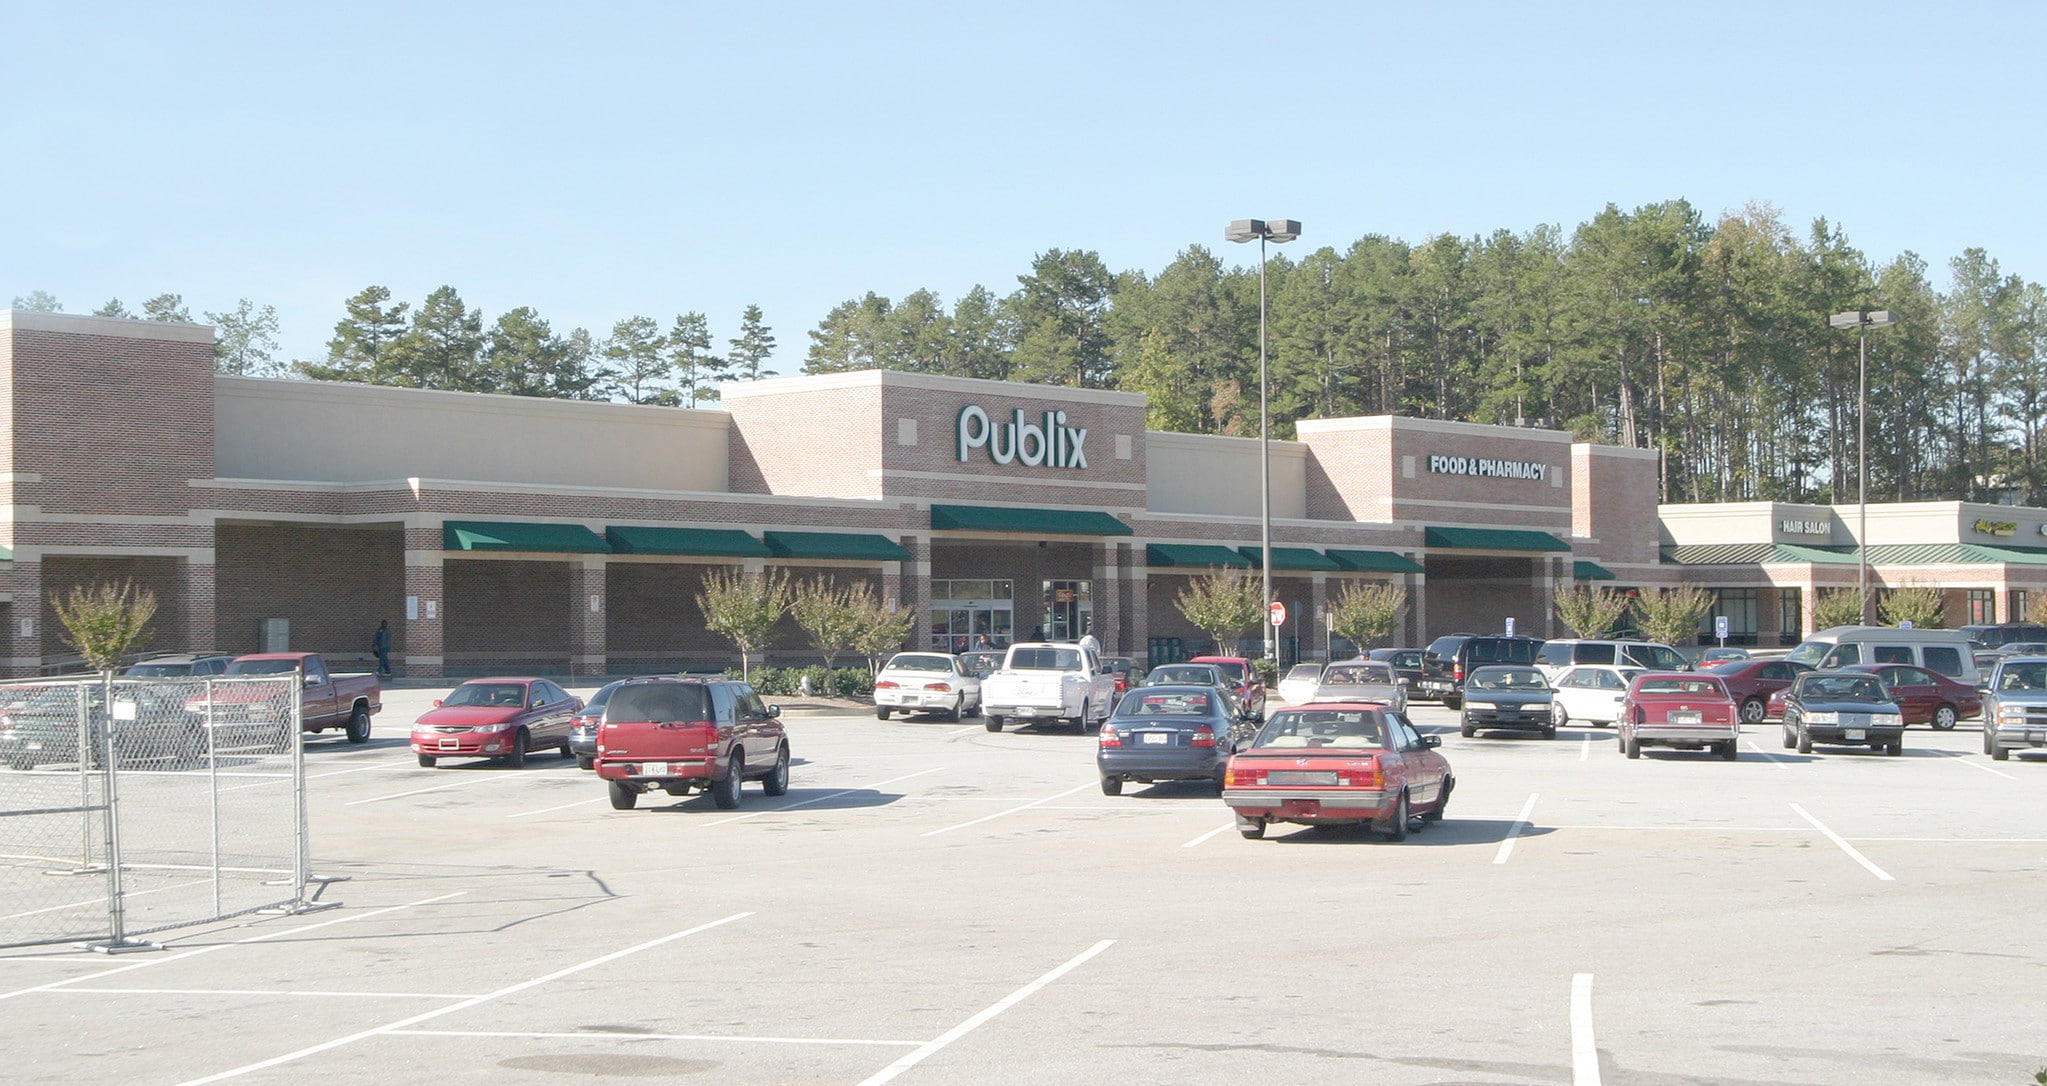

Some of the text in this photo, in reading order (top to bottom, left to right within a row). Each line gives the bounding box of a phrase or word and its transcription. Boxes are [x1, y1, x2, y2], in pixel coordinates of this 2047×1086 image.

[957, 404, 1088, 469] Publix
[1429, 455, 1467, 475] FOOD
[1479, 459, 1546, 480] PHARMACY
[1782, 519, 1831, 535] HAIR SALON
